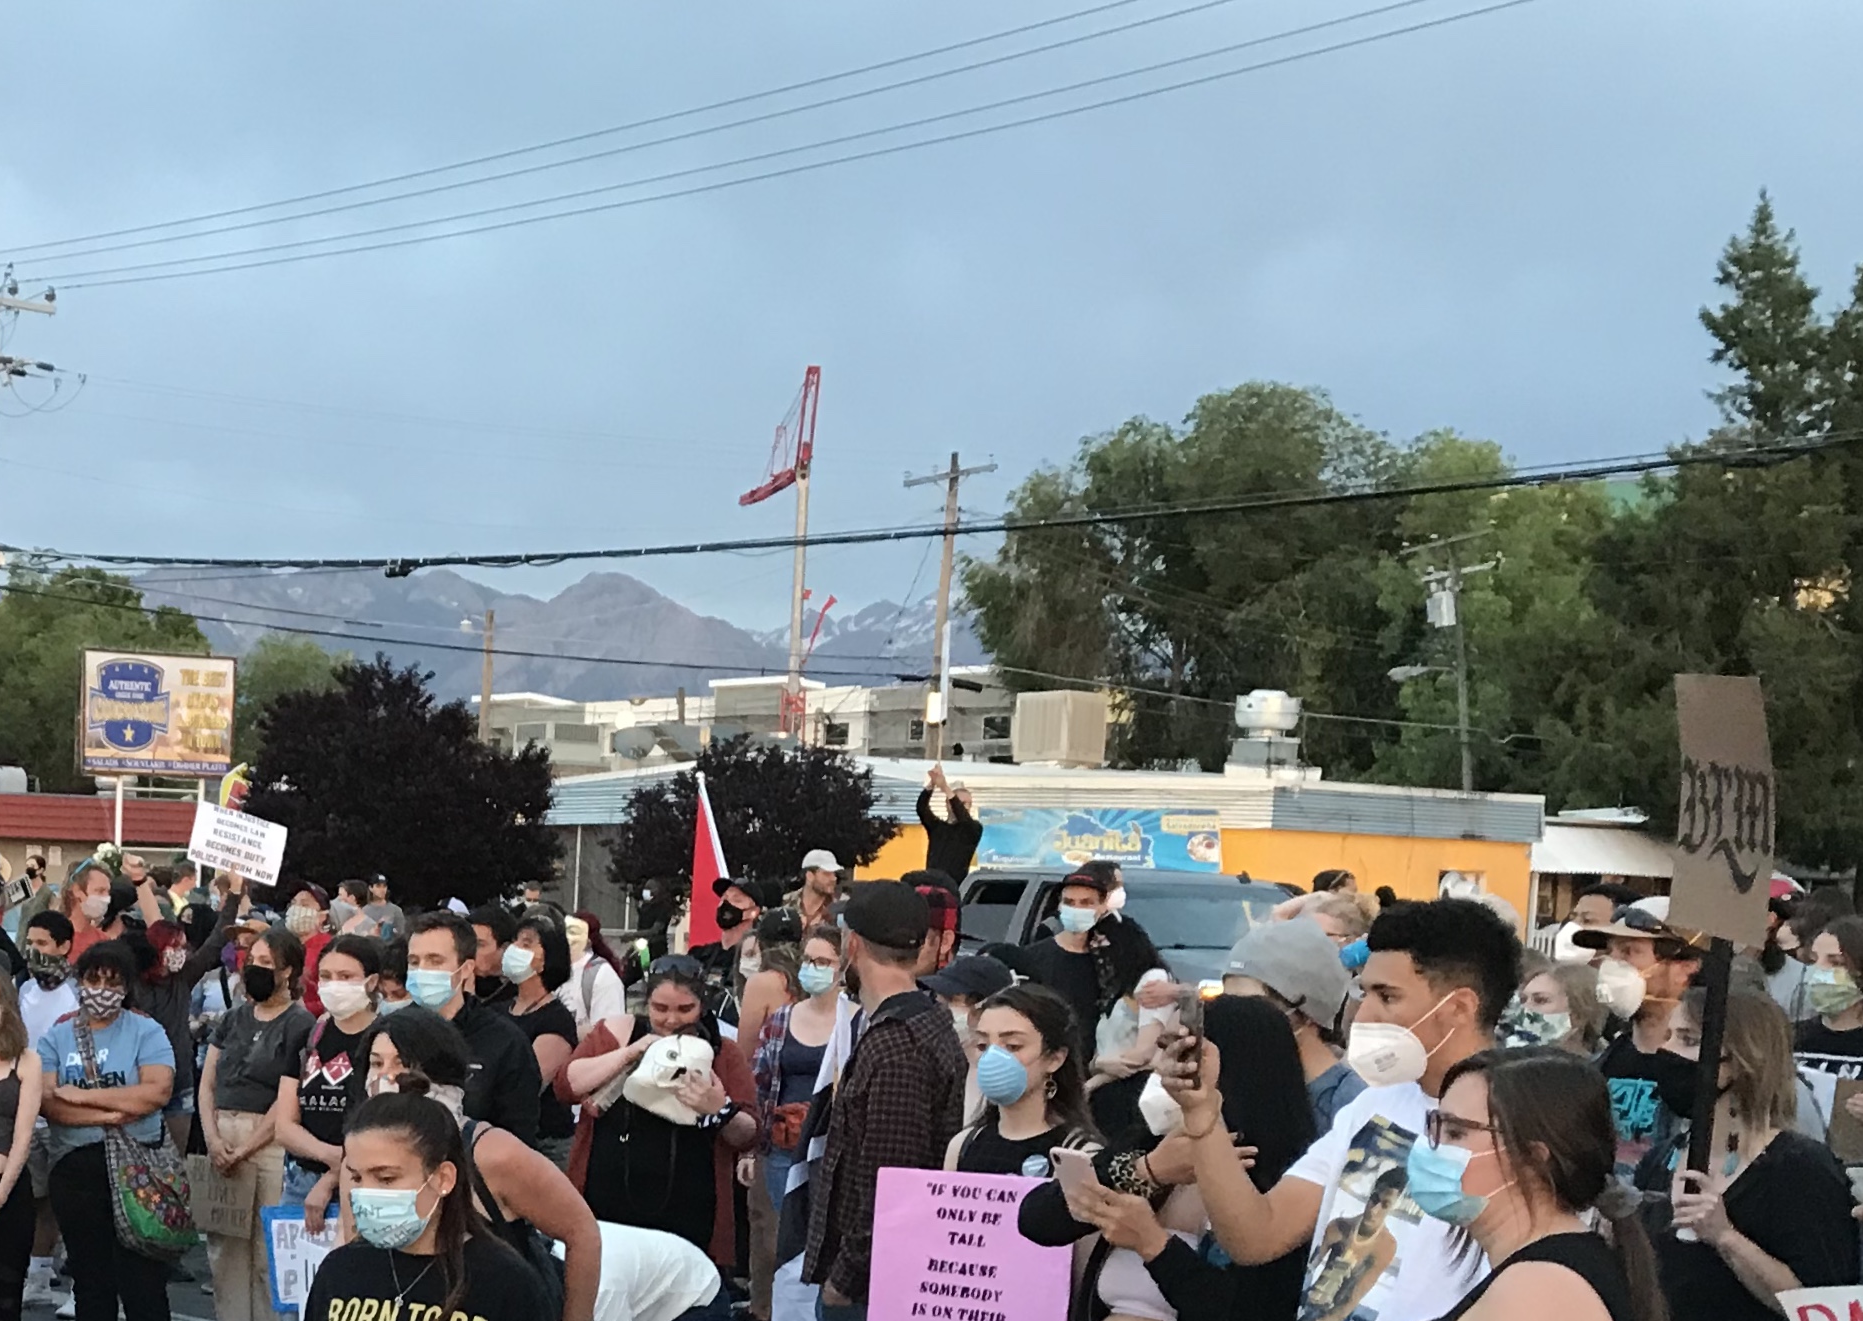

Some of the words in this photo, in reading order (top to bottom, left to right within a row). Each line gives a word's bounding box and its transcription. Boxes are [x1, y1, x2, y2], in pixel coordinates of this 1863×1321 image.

[213, 805, 234, 817] WHEN
[213, 828, 263, 850] RESISTANCE
[250, 827, 266, 839] LAW
[205, 839, 242, 857] BECOMES
[243, 851, 267, 865] DUTY
[190, 848, 219, 864] POLICE
[254, 868, 274, 881] NOW
[65, 1048, 109, 1067] DR
[951, 1185, 982, 1200] YOU
[986, 1188, 1018, 1203] CAN
[936, 1207, 977, 1223] ONLY
[981, 1211, 1002, 1226] BE
[948, 1231, 986, 1248] TALL
[927, 1258, 998, 1279] BECAUSE
[919, 1281, 1003, 1303] SOMEBODY
[911, 1302, 926, 1317] IS
[932, 1304, 953, 1319] ON
